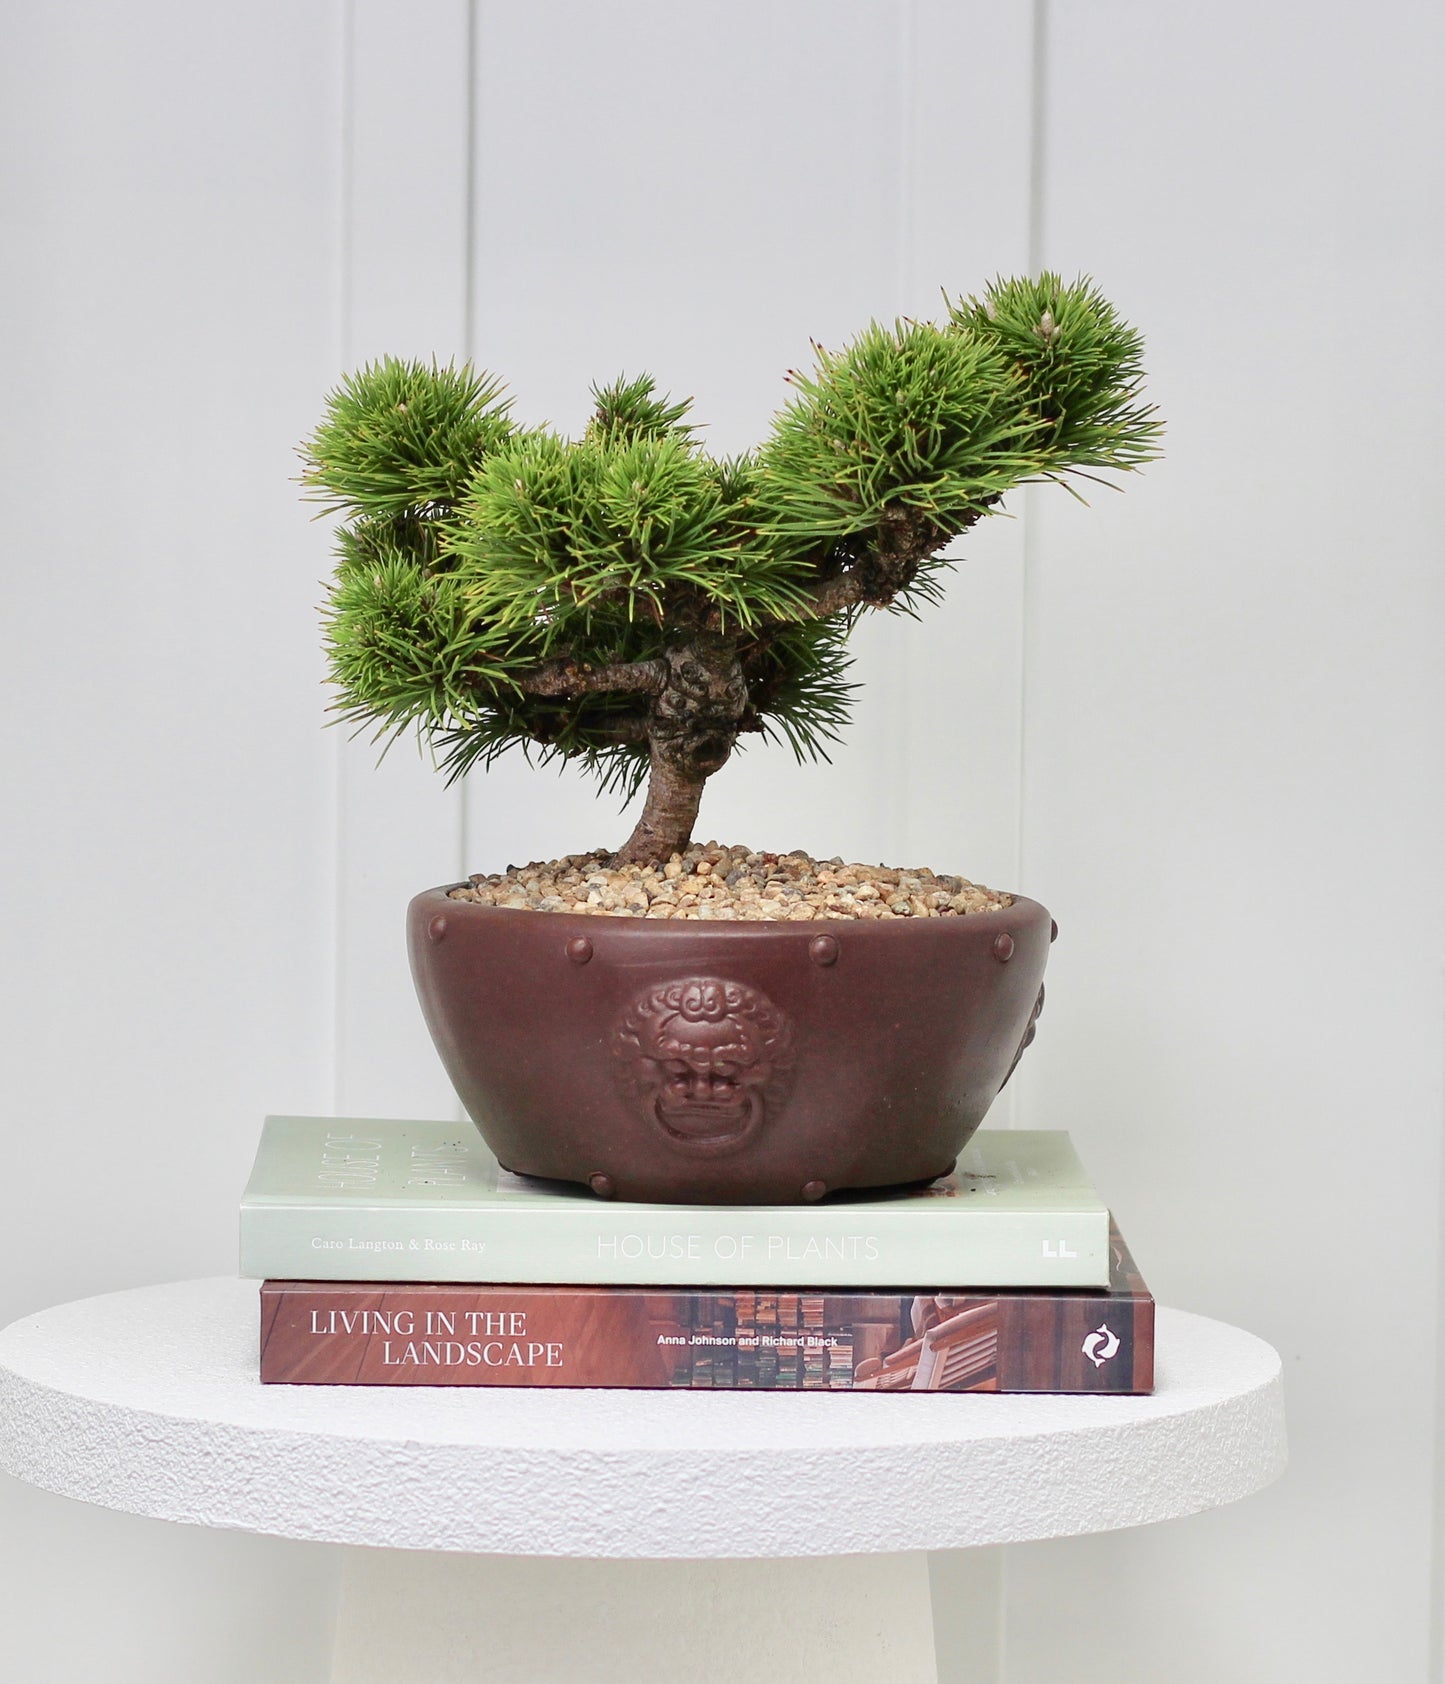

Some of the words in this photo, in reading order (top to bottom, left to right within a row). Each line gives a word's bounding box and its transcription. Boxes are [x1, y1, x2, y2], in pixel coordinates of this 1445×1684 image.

[311, 1237, 344, 1249] Caro
[349, 1238, 404, 1252] Langton
[408, 1238, 419, 1250] &
[424, 1239, 456, 1250] Rose
[461, 1239, 486, 1253] Ray
[596, 1234, 701, 1259] HOUSE
[714, 1235, 755, 1260] OF
[768, 1236, 880, 1261] PLANTS
[310, 1310, 414, 1335] LIVING
[425, 1311, 456, 1336] IN
[465, 1311, 527, 1336] THE
[657, 1334, 686, 1346] Anna
[688, 1334, 736, 1346] Johnson
[738, 1335, 759, 1346] and
[762, 1335, 805, 1347] Richard
[807, 1336, 838, 1347] Black
[382, 1341, 564, 1367] LANDSCAPE
